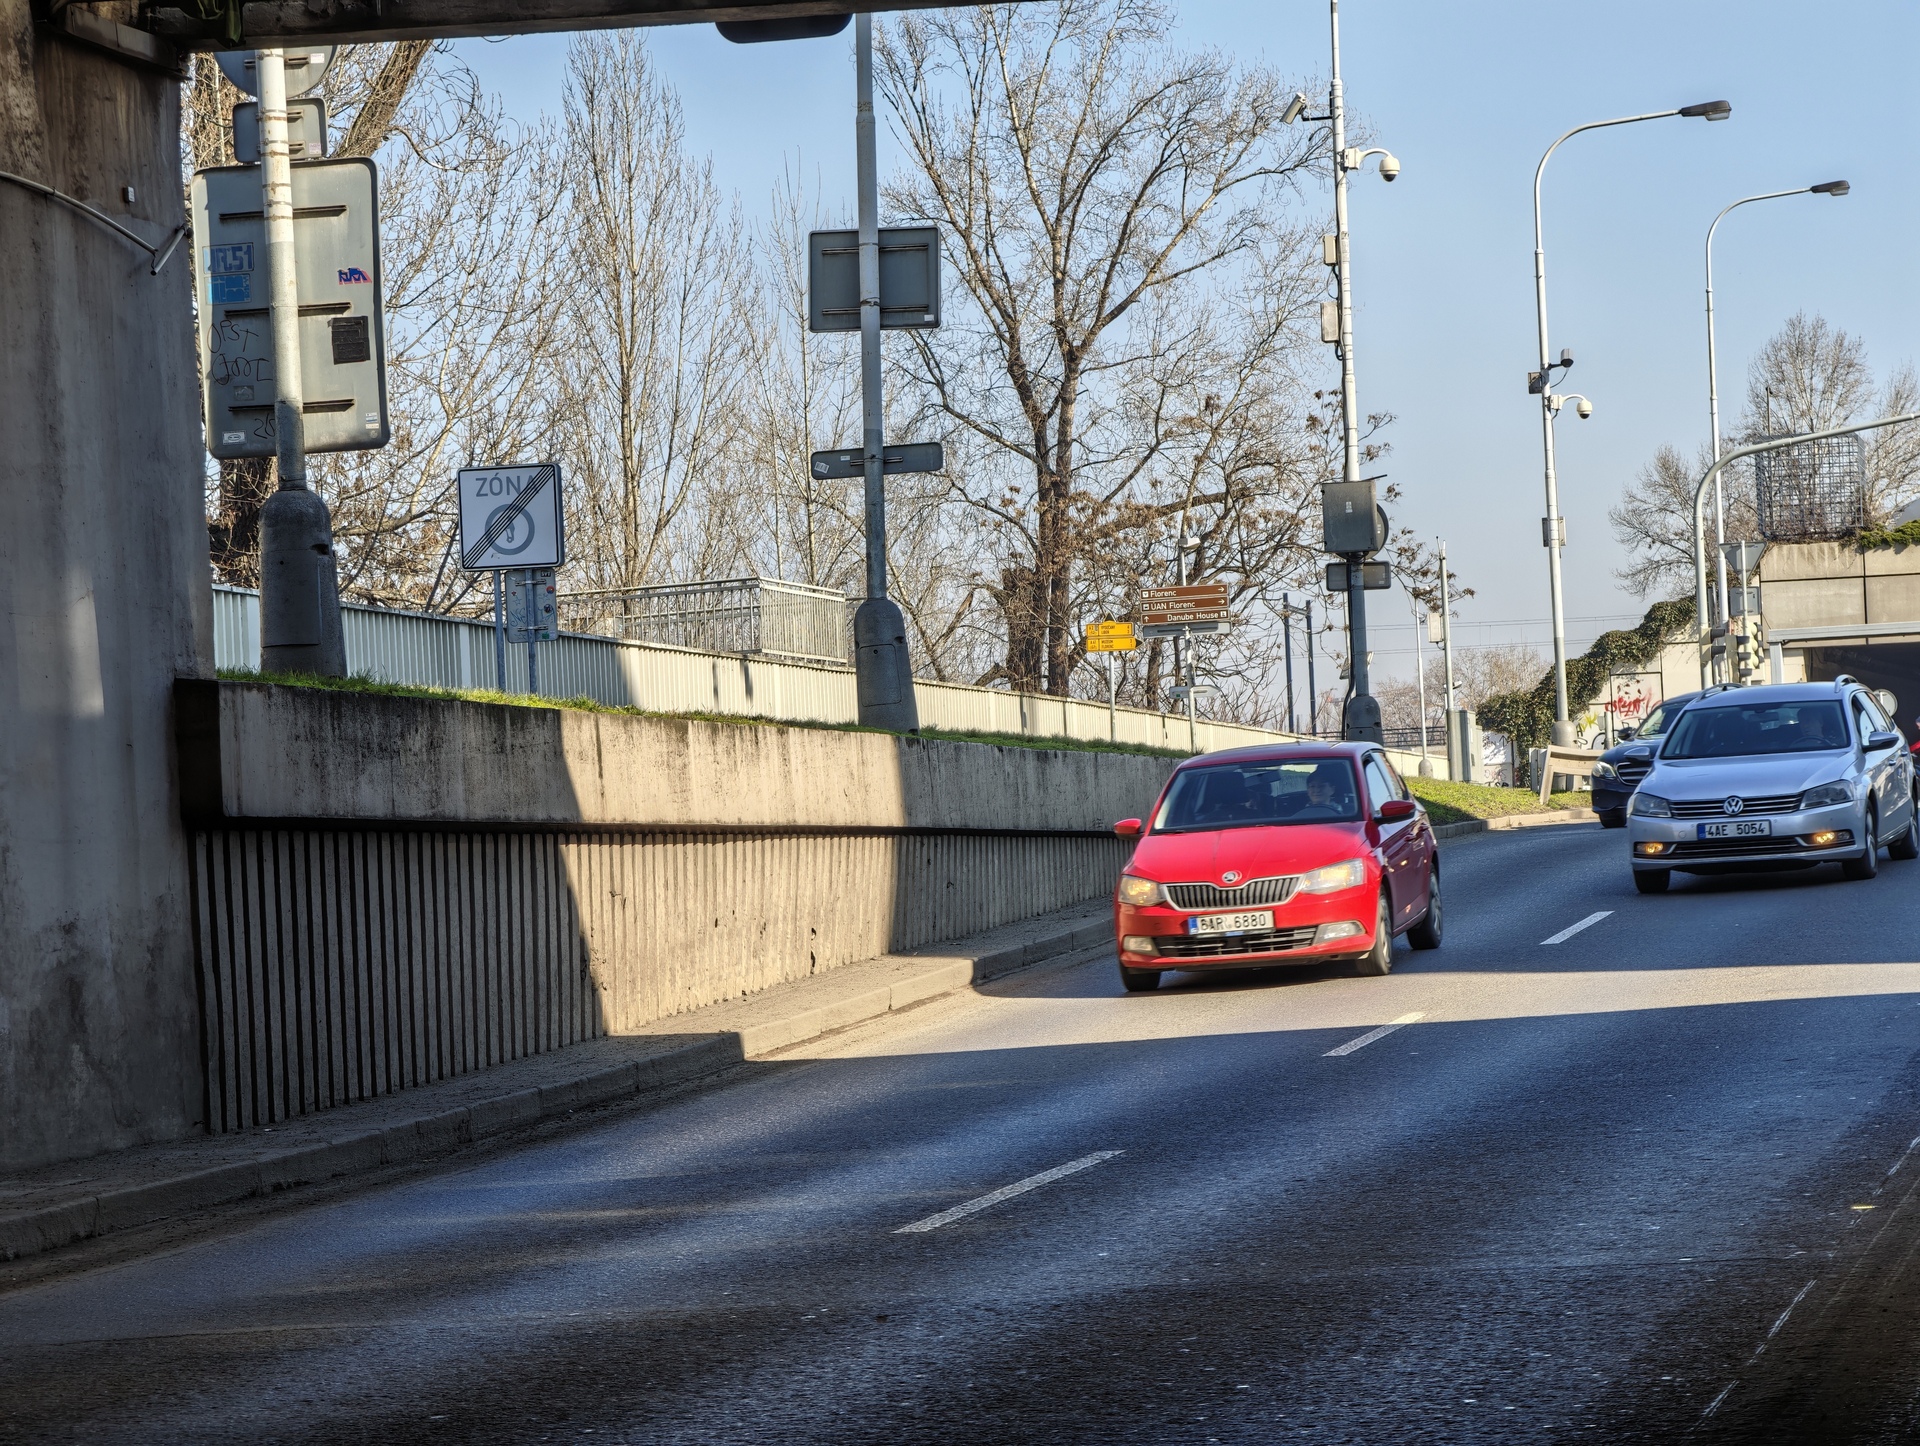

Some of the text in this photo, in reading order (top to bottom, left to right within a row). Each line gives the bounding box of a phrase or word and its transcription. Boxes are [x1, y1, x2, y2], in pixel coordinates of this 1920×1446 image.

[1150, 590, 1177, 598] Florenc
[1151, 601, 1167, 610] ÚAN
[1167, 612, 1219, 622] Danube House
[1706, 822, 1766, 837] 4AE 5054
[1234, 913, 1266, 929] 6880
